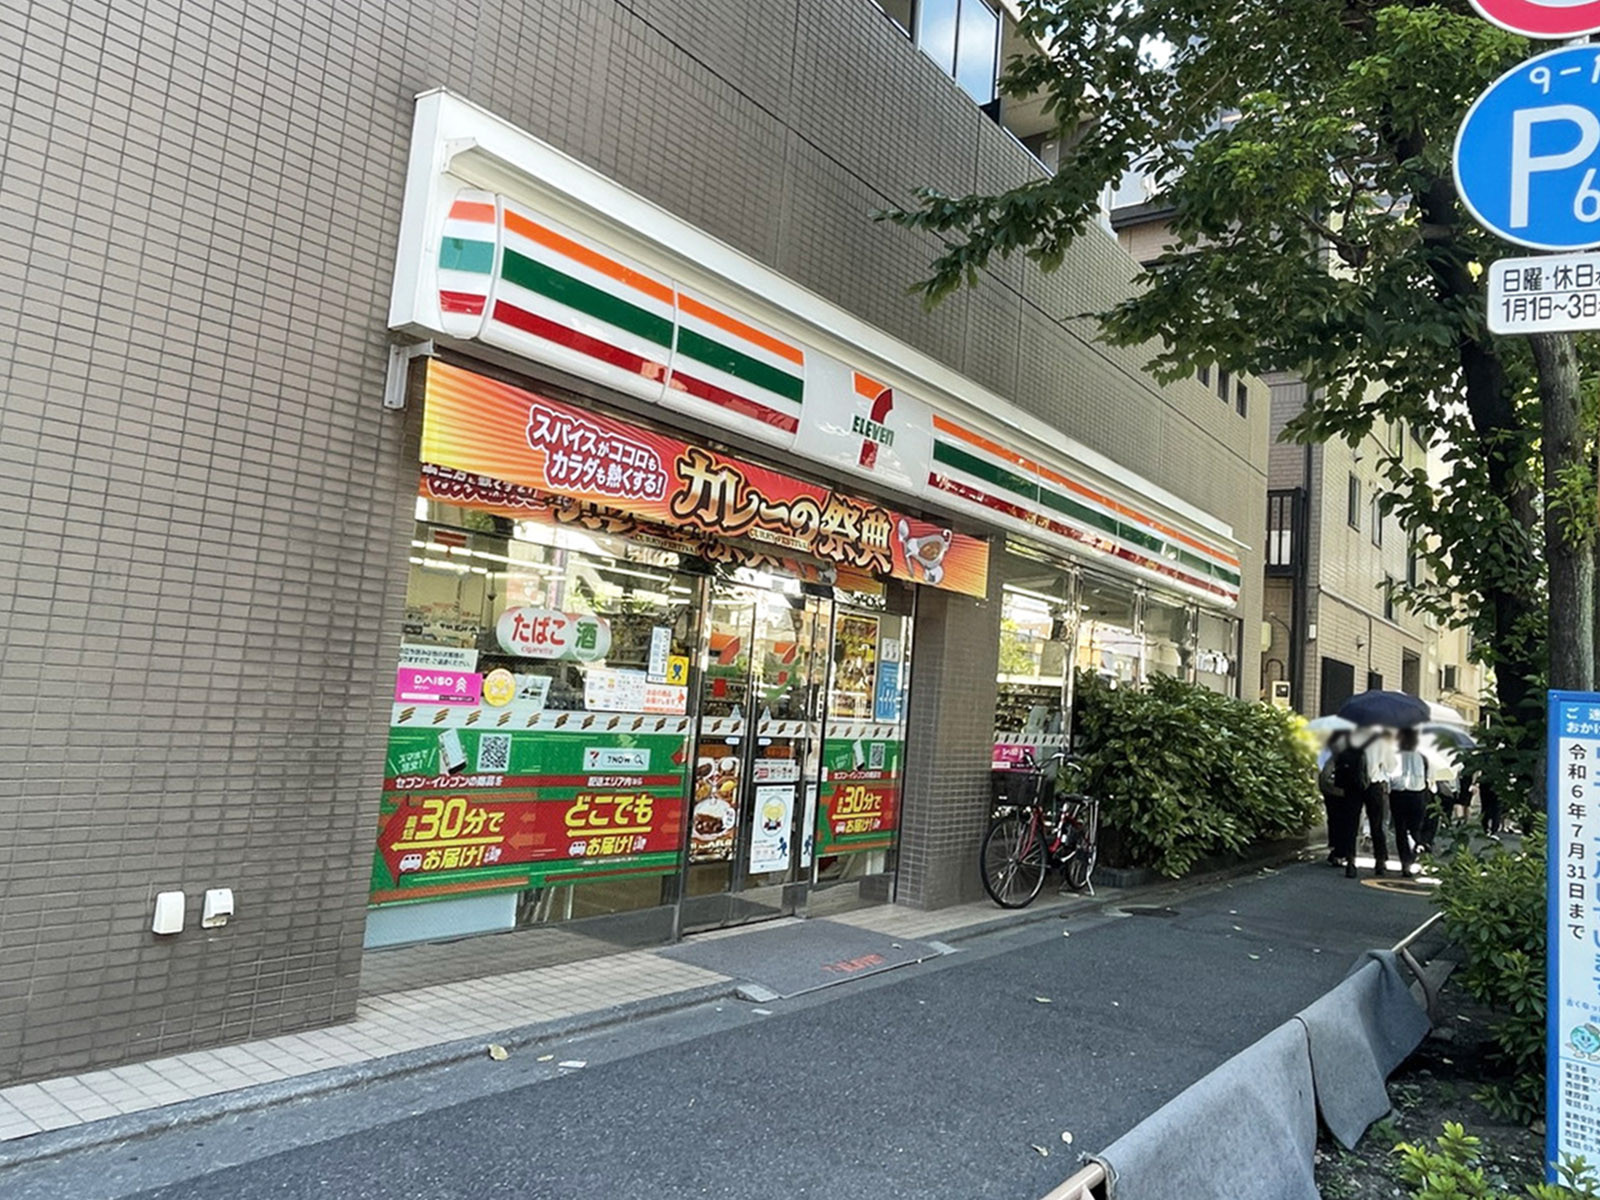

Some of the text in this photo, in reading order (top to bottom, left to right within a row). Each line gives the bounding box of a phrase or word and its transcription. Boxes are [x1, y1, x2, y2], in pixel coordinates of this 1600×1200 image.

[1509, 104, 1600, 229] P
[1503, 263, 1600, 293] 日曜・休日
[1501, 294, 1600, 323] 1月1日~3日
[533, 413, 657, 472] スパイスがココロも
[550, 450, 664, 495] カラダも熱くする!
[673, 448, 892, 574] カレーの祭典
[512, 613, 566, 646] たばこ
[575, 621, 598, 649] 酒
[565, 794, 653, 827] どこでも
[422, 845, 485, 870] お届け!
[586, 835, 634, 856] お届け!
[1566, 743, 1588, 941] 令和6年7月31日まで
